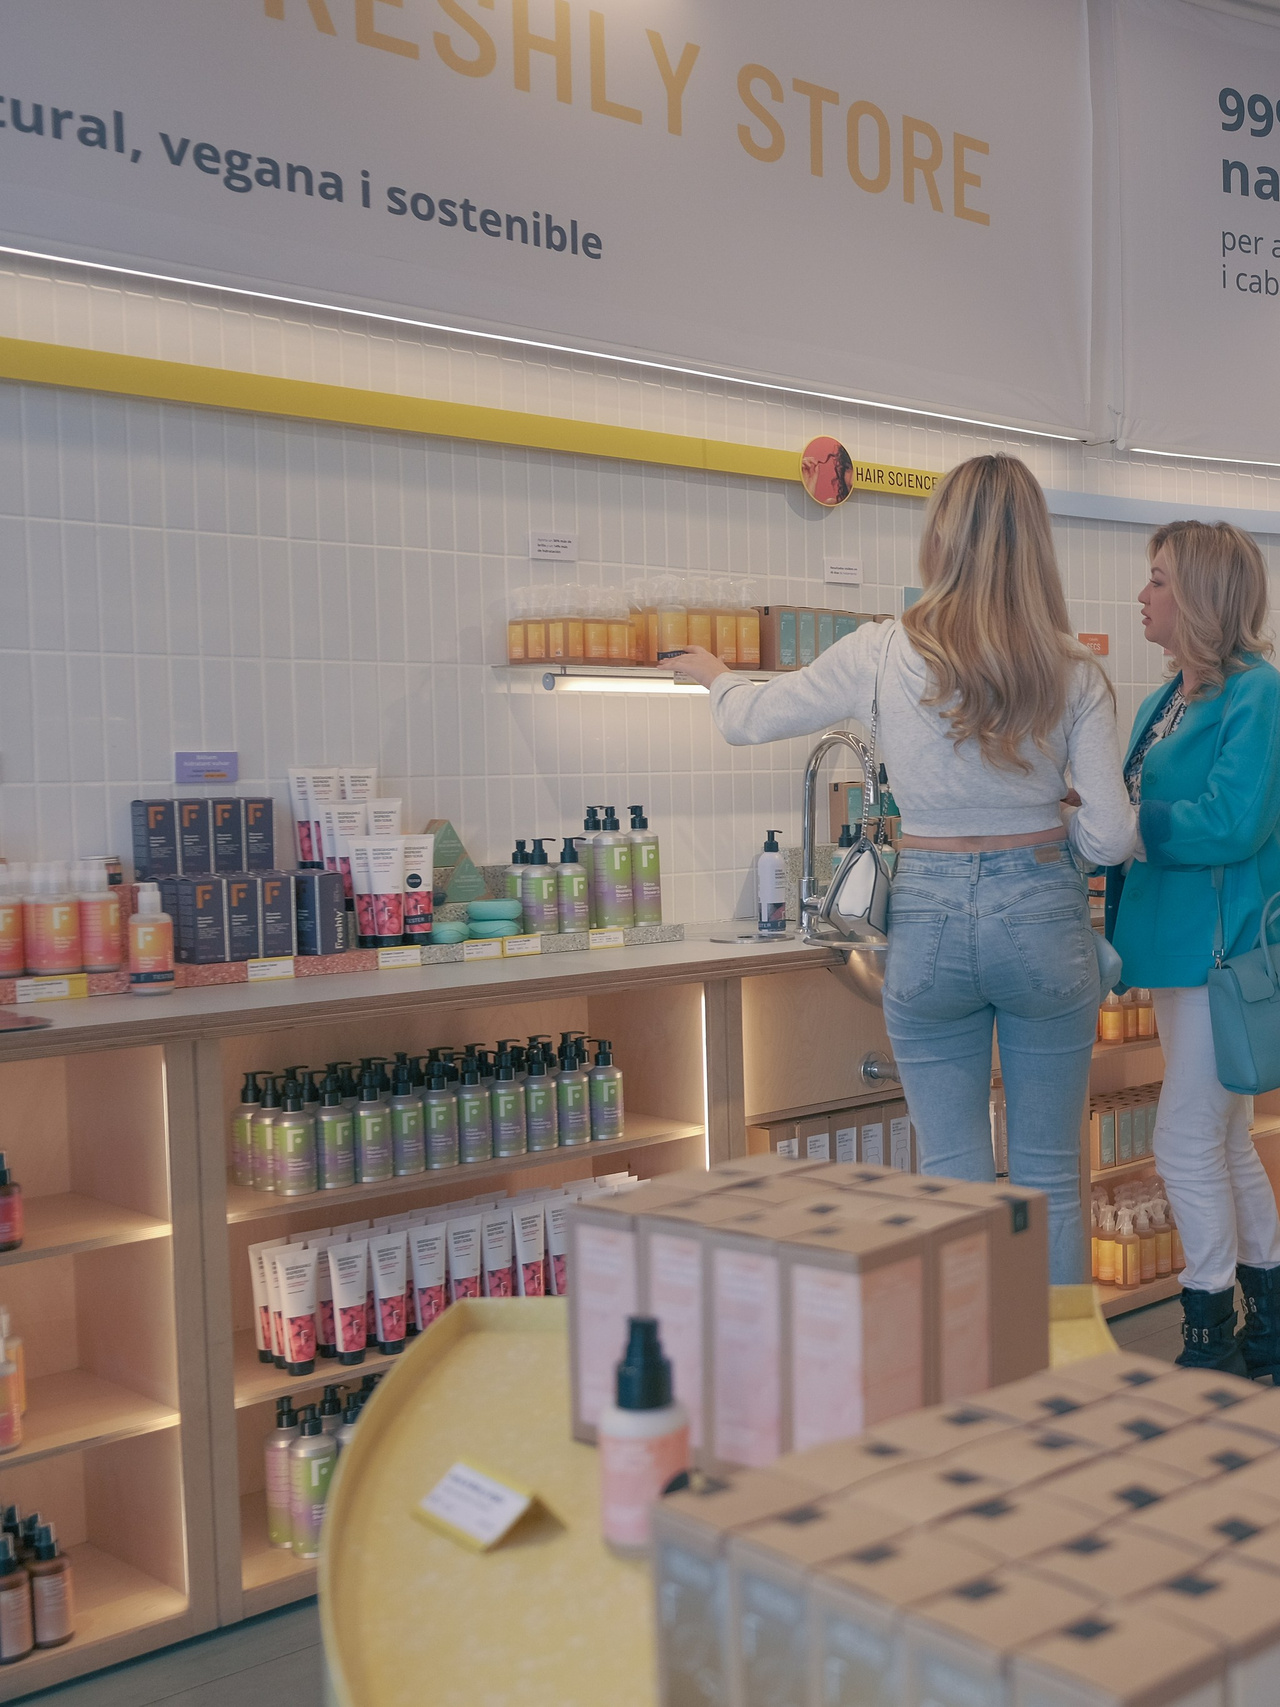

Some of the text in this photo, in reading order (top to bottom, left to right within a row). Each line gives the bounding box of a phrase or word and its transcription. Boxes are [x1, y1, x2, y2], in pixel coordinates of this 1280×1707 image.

[264, 0, 991, 226] SHLY STORE
[0, 95, 603, 260] ural, vegana i sostenible
[1221, 229, 1264, 258] per
[1221, 264, 1227, 289] i
[856, 466, 939, 490] HAIR SCIENCE
[335, 911, 345, 949] Freshly
